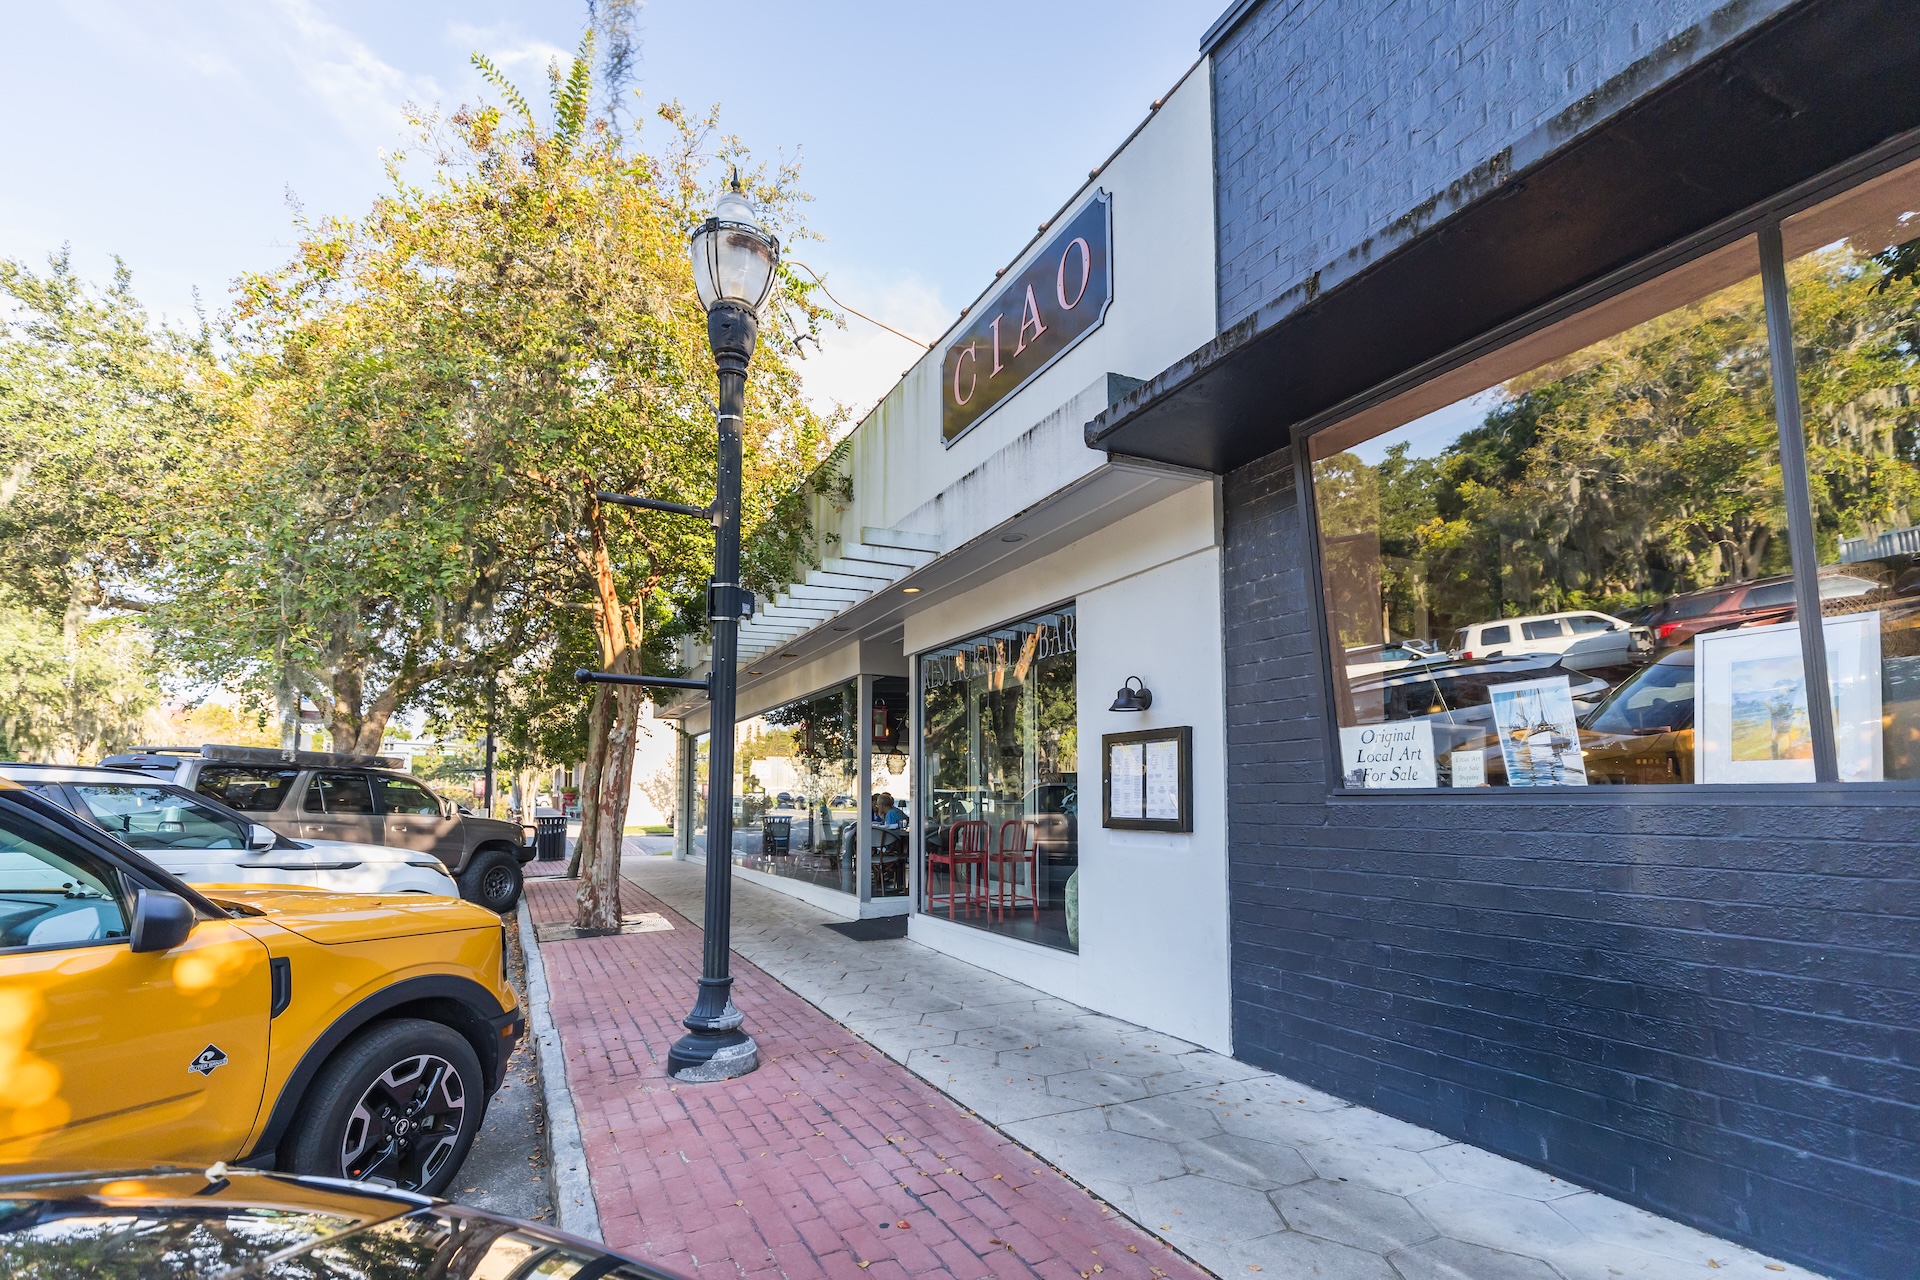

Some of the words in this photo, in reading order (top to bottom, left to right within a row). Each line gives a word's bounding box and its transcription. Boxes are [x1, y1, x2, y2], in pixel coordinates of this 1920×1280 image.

[954, 237, 1091, 406] CIAO
[923, 633, 1015, 690] RESTAURANT
[1019, 630, 1033, 664] &
[1038, 613, 1076, 660] BAR
[1361, 725, 1416, 748] Original
[1356, 747, 1394, 763] Local
[1398, 746, 1422, 761] Art
[1363, 767, 1386, 782] For
[1390, 766, 1418, 782] Sale
